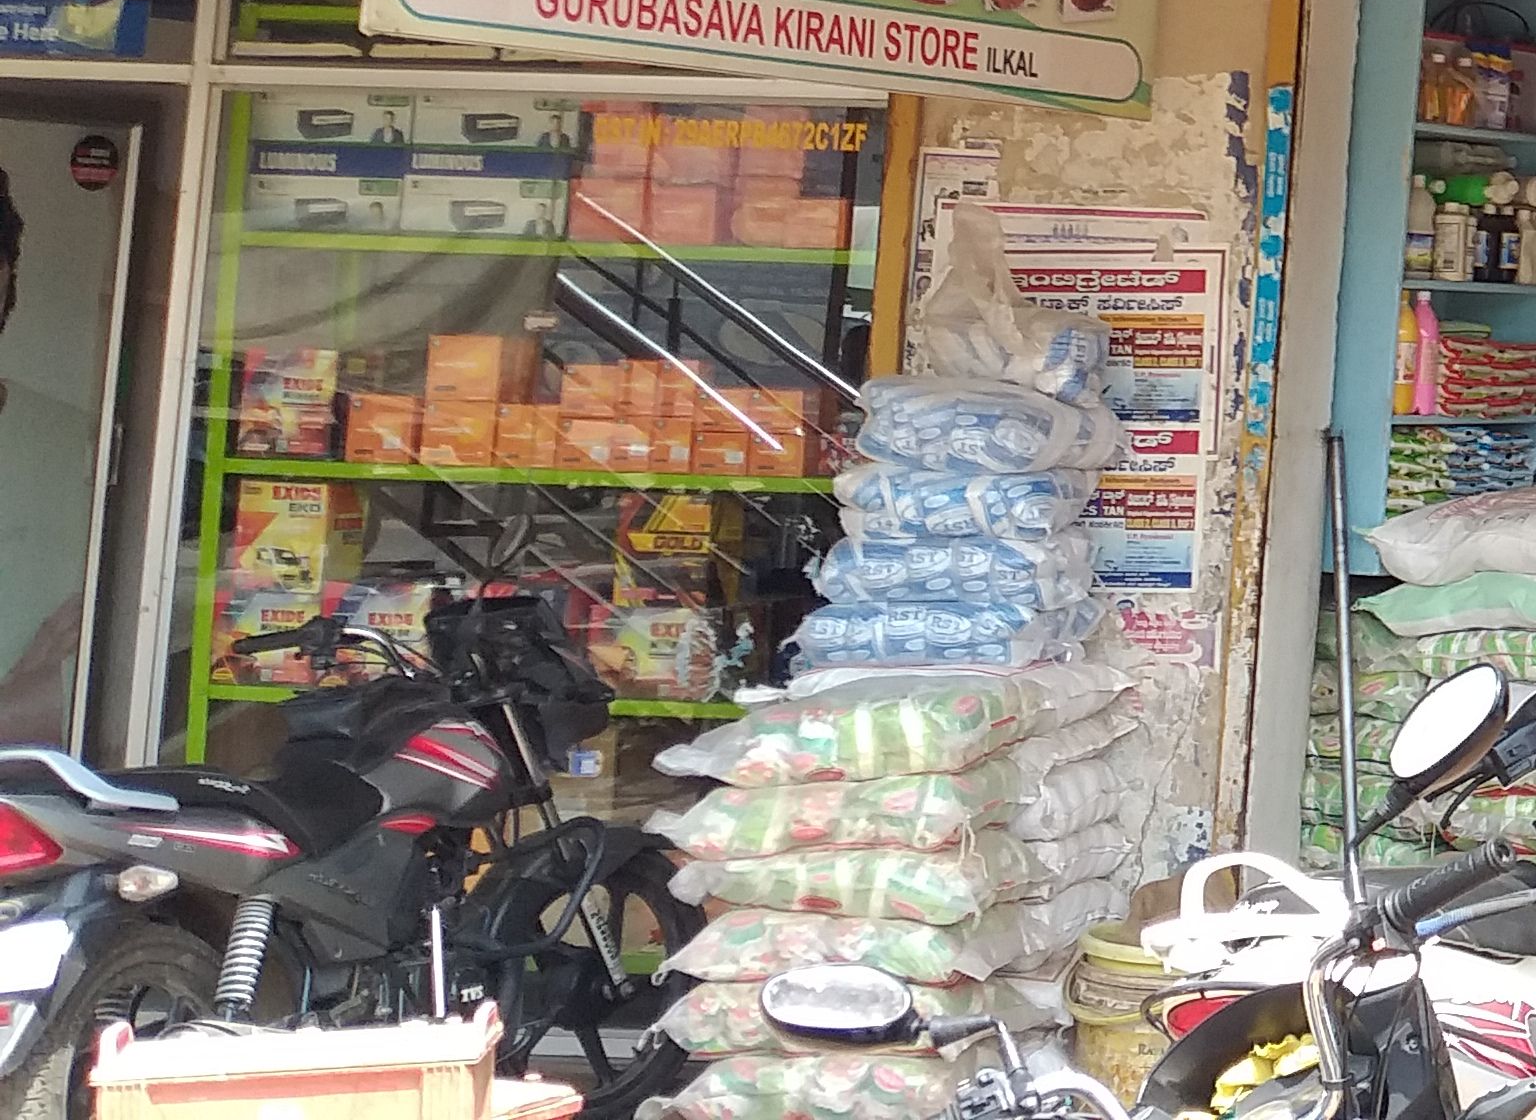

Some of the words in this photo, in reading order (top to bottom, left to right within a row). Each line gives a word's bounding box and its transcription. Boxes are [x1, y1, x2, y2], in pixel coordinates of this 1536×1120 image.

[774, 6, 876, 59] KIRANI
[884, 21, 980, 71] STORE
[986, 47, 1038, 78] ILKAL
